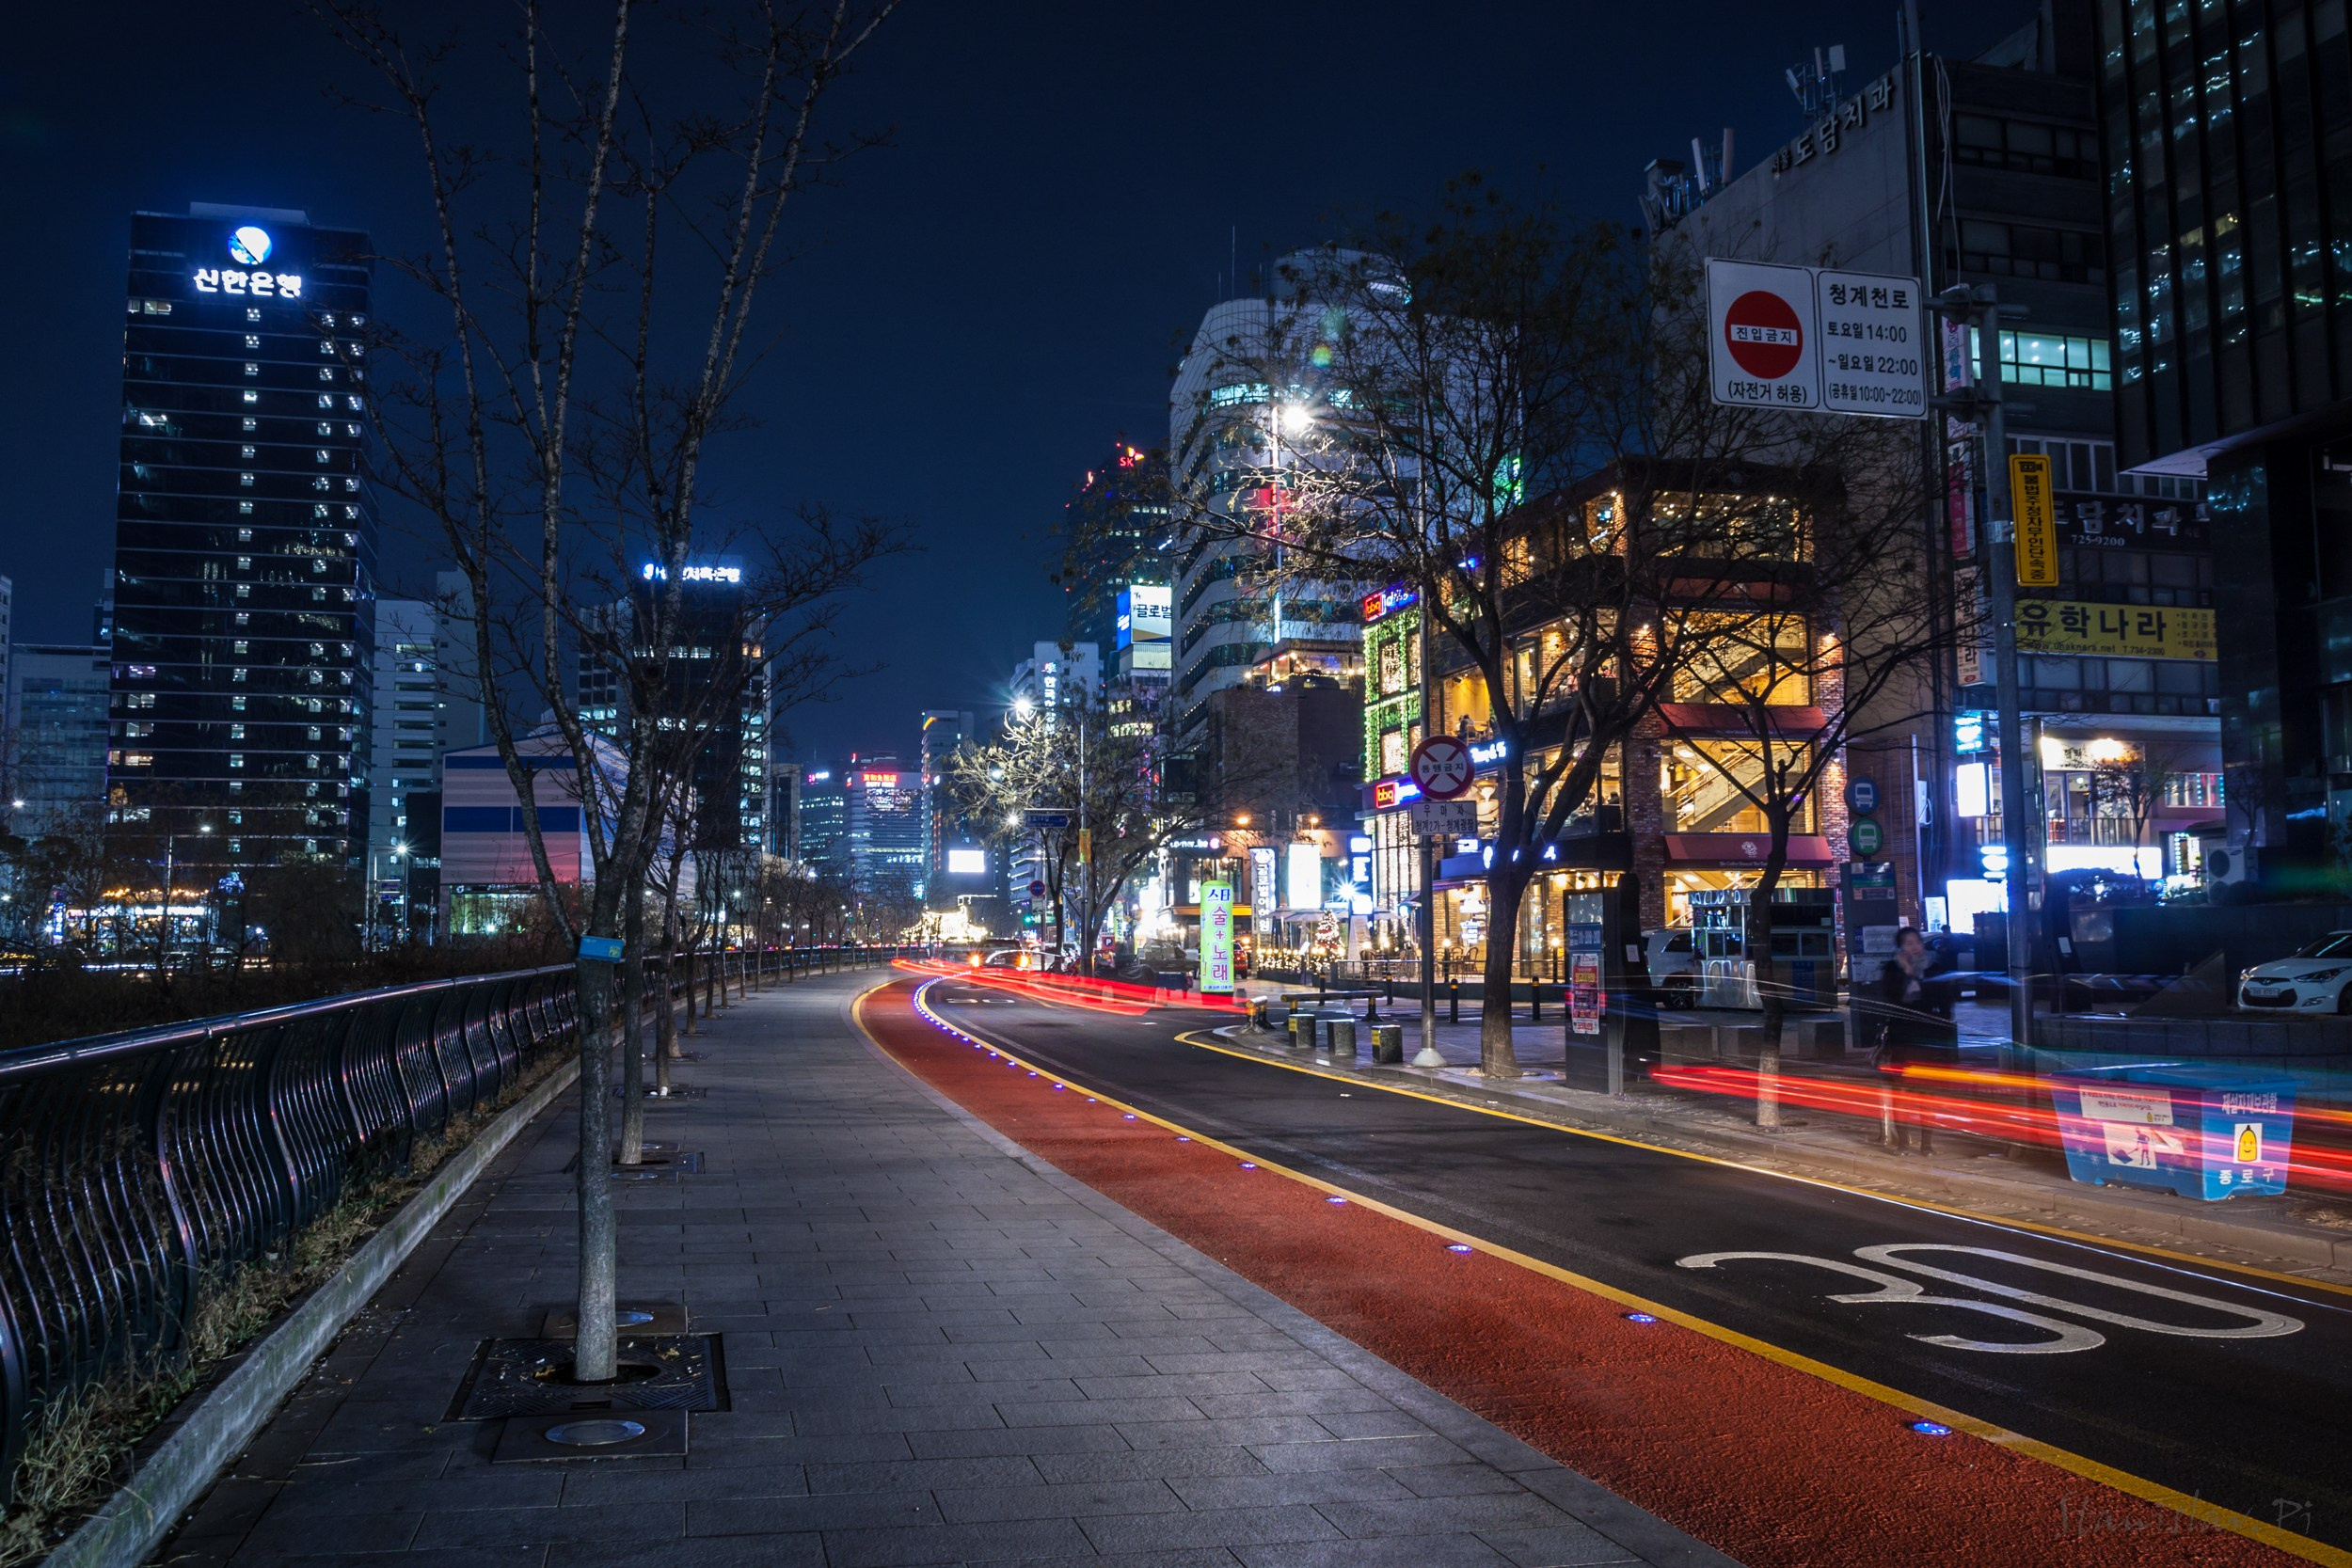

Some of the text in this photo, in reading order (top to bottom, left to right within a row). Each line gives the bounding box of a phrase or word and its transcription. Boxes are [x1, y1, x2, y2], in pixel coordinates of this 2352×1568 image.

[1794, 76, 1893, 166] 도담치과
[193, 269, 302, 298] 신한은행
[1829, 284, 1910, 309] 청계천로
[1736, 326, 1792, 344] 진입금지
[1827, 322, 1907, 343] 토요일 14:00
[1878, 356, 1918, 376] 22:00
[1728, 380, 1807, 404] (자전거 허용)
[2071, 534, 2126, 546] 725-9200
[2020, 604, 2167, 642] 유학나라
[1422, 762, 1464, 774] 통행금지
[1377, 788, 1393, 802] bbq
[1208, 888, 1232, 902] 스타
[1105, 937, 1112, 946] P
[2221, 1092, 2278, 1115] 제설자재보관함
[1676, 1243, 2306, 1354] 30
